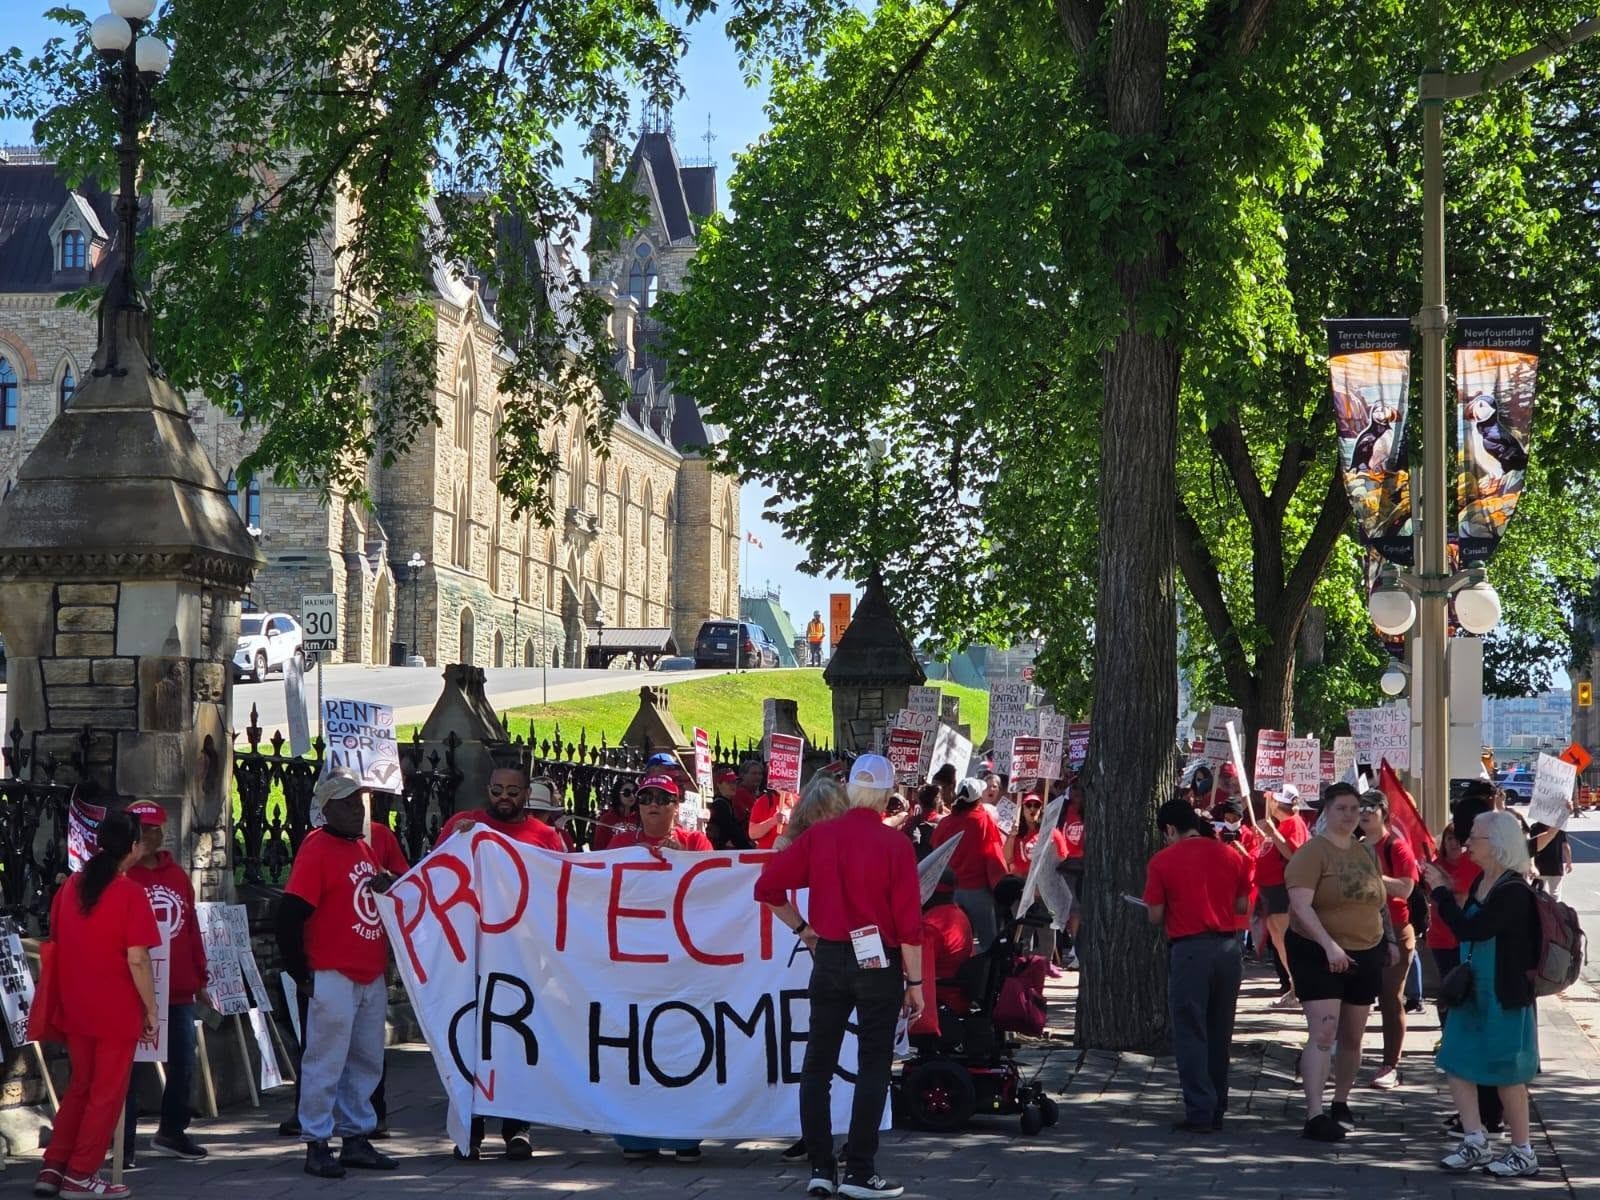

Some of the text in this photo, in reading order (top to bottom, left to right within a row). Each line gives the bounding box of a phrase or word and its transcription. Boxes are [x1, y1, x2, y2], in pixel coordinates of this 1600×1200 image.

[1337, 330, 1401, 340] Terre-Neuve-
[1464, 327, 1534, 338] Newfoundland
[1340, 340, 1399, 349] et-Labrador
[1467, 337, 1531, 347] and Labrador
[306, 611, 333, 635] 30
[303, 640, 335, 650] km/h
[325, 700, 382, 726] RENT
[900, 711, 933, 726] STOP
[998, 714, 1032, 728] MARK
[326, 720, 397, 741] CONTROL
[1372, 724, 1388, 734] ARE
[328, 734, 375, 751] FOR
[1069, 737, 1090, 746] PROTEC
[1372, 735, 1408, 748] ASSETS
[888, 746, 919, 756] PROTECT
[1044, 742, 1059, 754] NOT
[770, 752, 799, 763] PROTECT
[890, 754, 907, 762] OUR
[772, 760, 787, 769] OUR
[769, 766, 798, 779] HOMES
[1256, 766, 1284, 776] HOMES
[1298, 772, 1318, 781] THE
[1296, 783, 1319, 794] TION
[386, 830, 778, 985] PROTECT
[352, 922, 385, 942] ALBERT
[0, 953, 30, 977] EALTH
[2, 974, 27, 995] CARE
